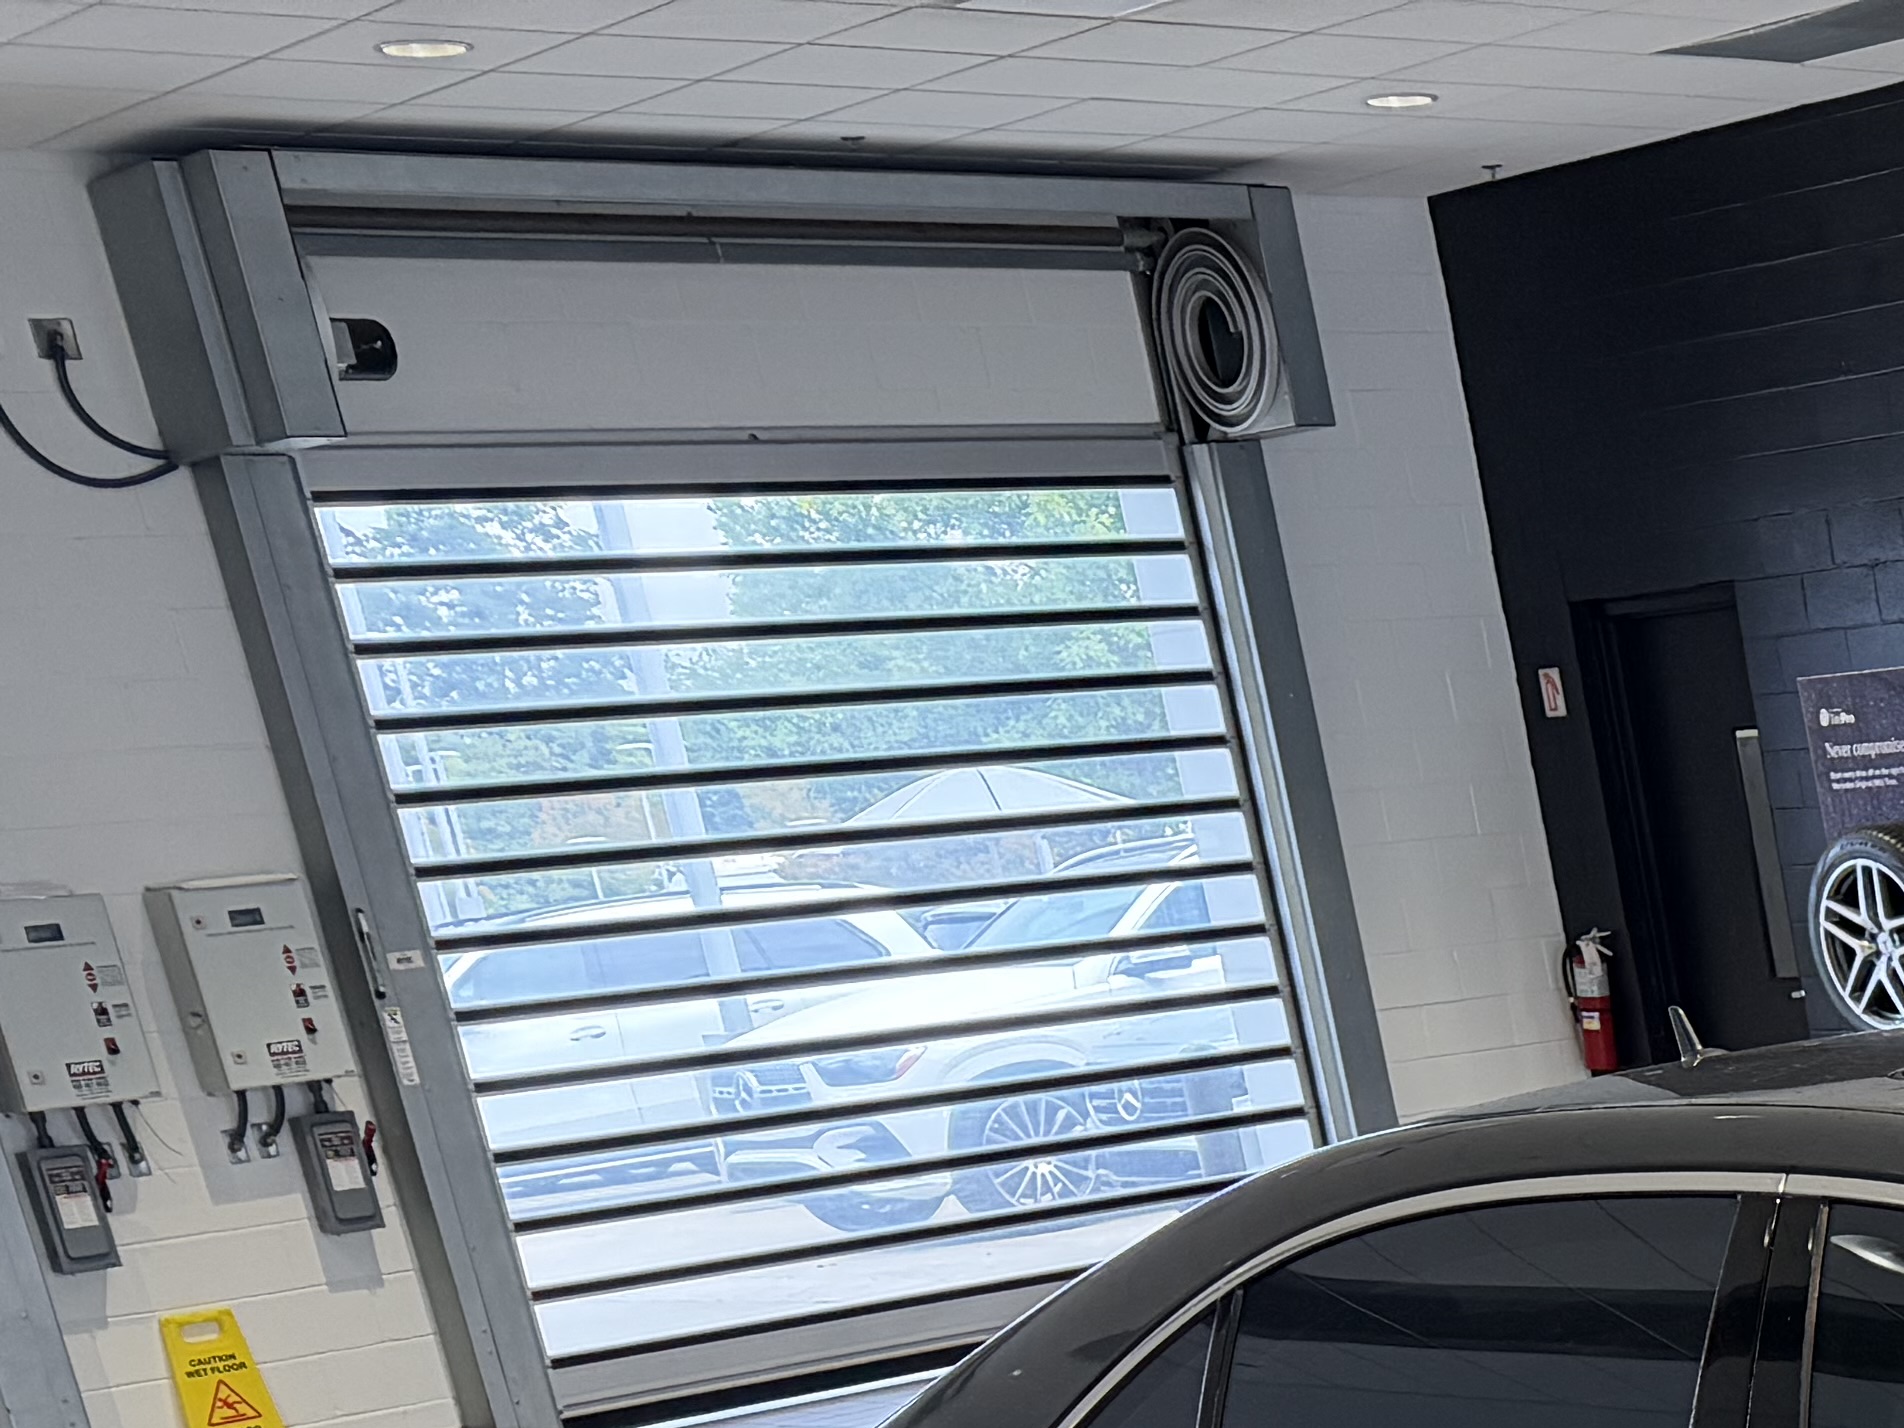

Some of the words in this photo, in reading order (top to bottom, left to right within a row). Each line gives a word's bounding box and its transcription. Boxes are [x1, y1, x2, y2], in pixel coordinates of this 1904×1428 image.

[188, 1353, 237, 1368] CAUTION
[185, 1367, 208, 1378] WET
[210, 1361, 248, 1374] FLOOR
